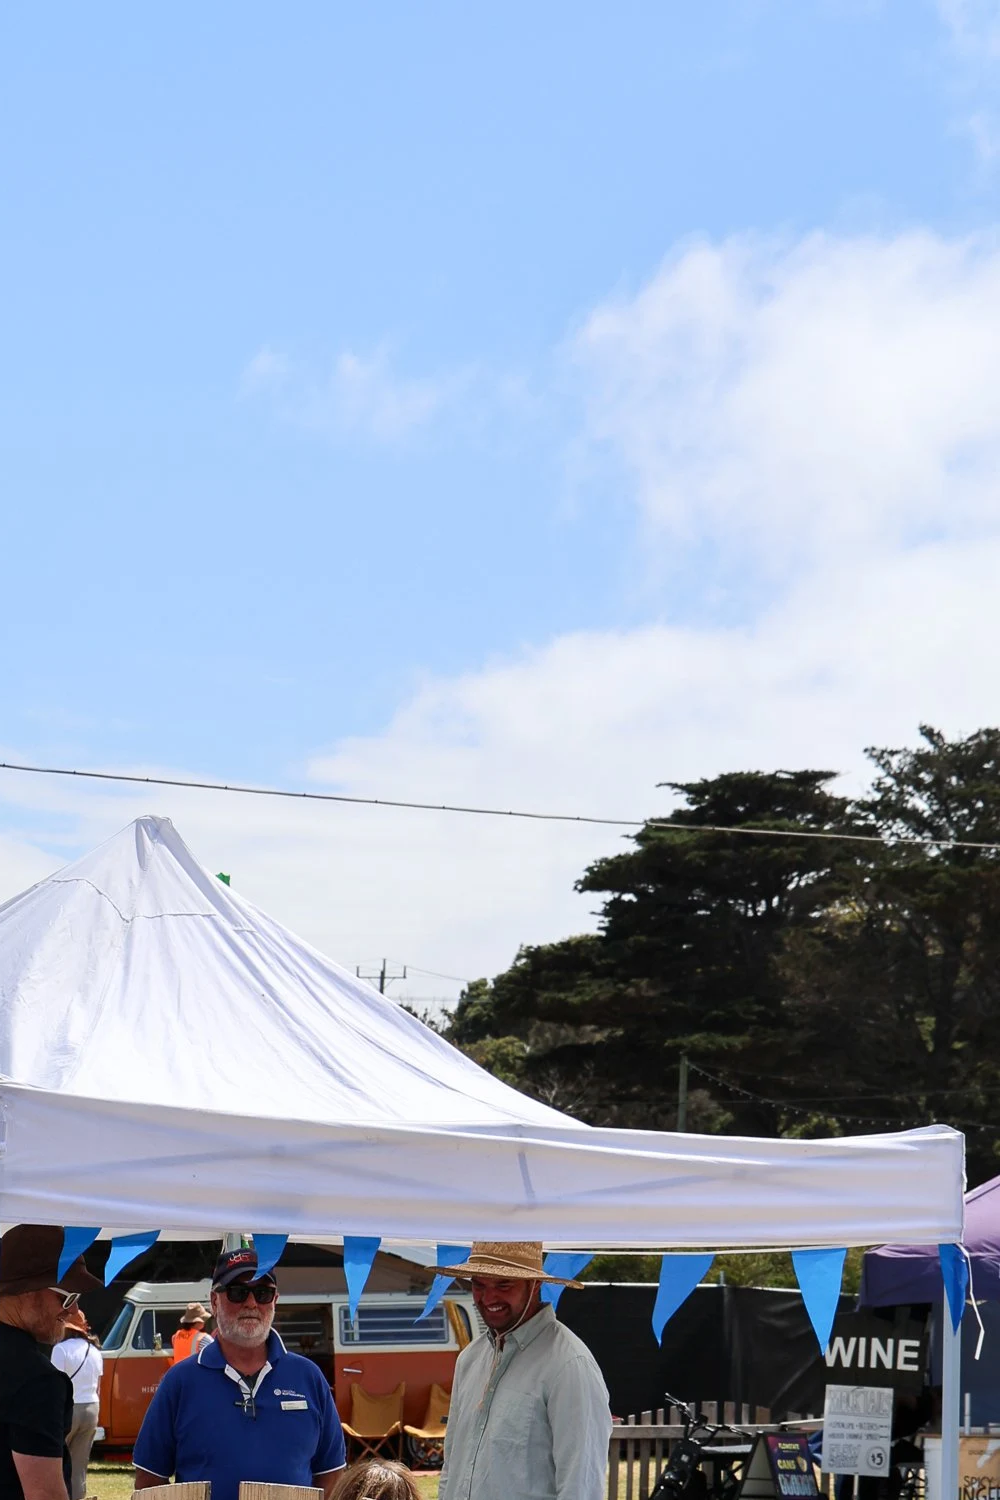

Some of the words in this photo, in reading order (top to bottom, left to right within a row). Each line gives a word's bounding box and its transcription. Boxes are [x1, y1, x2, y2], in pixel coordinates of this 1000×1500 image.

[825, 1336, 920, 1371] WINE
[777, 1459, 797, 1470] CANS
[870, 1453, 884, 1466] $5
